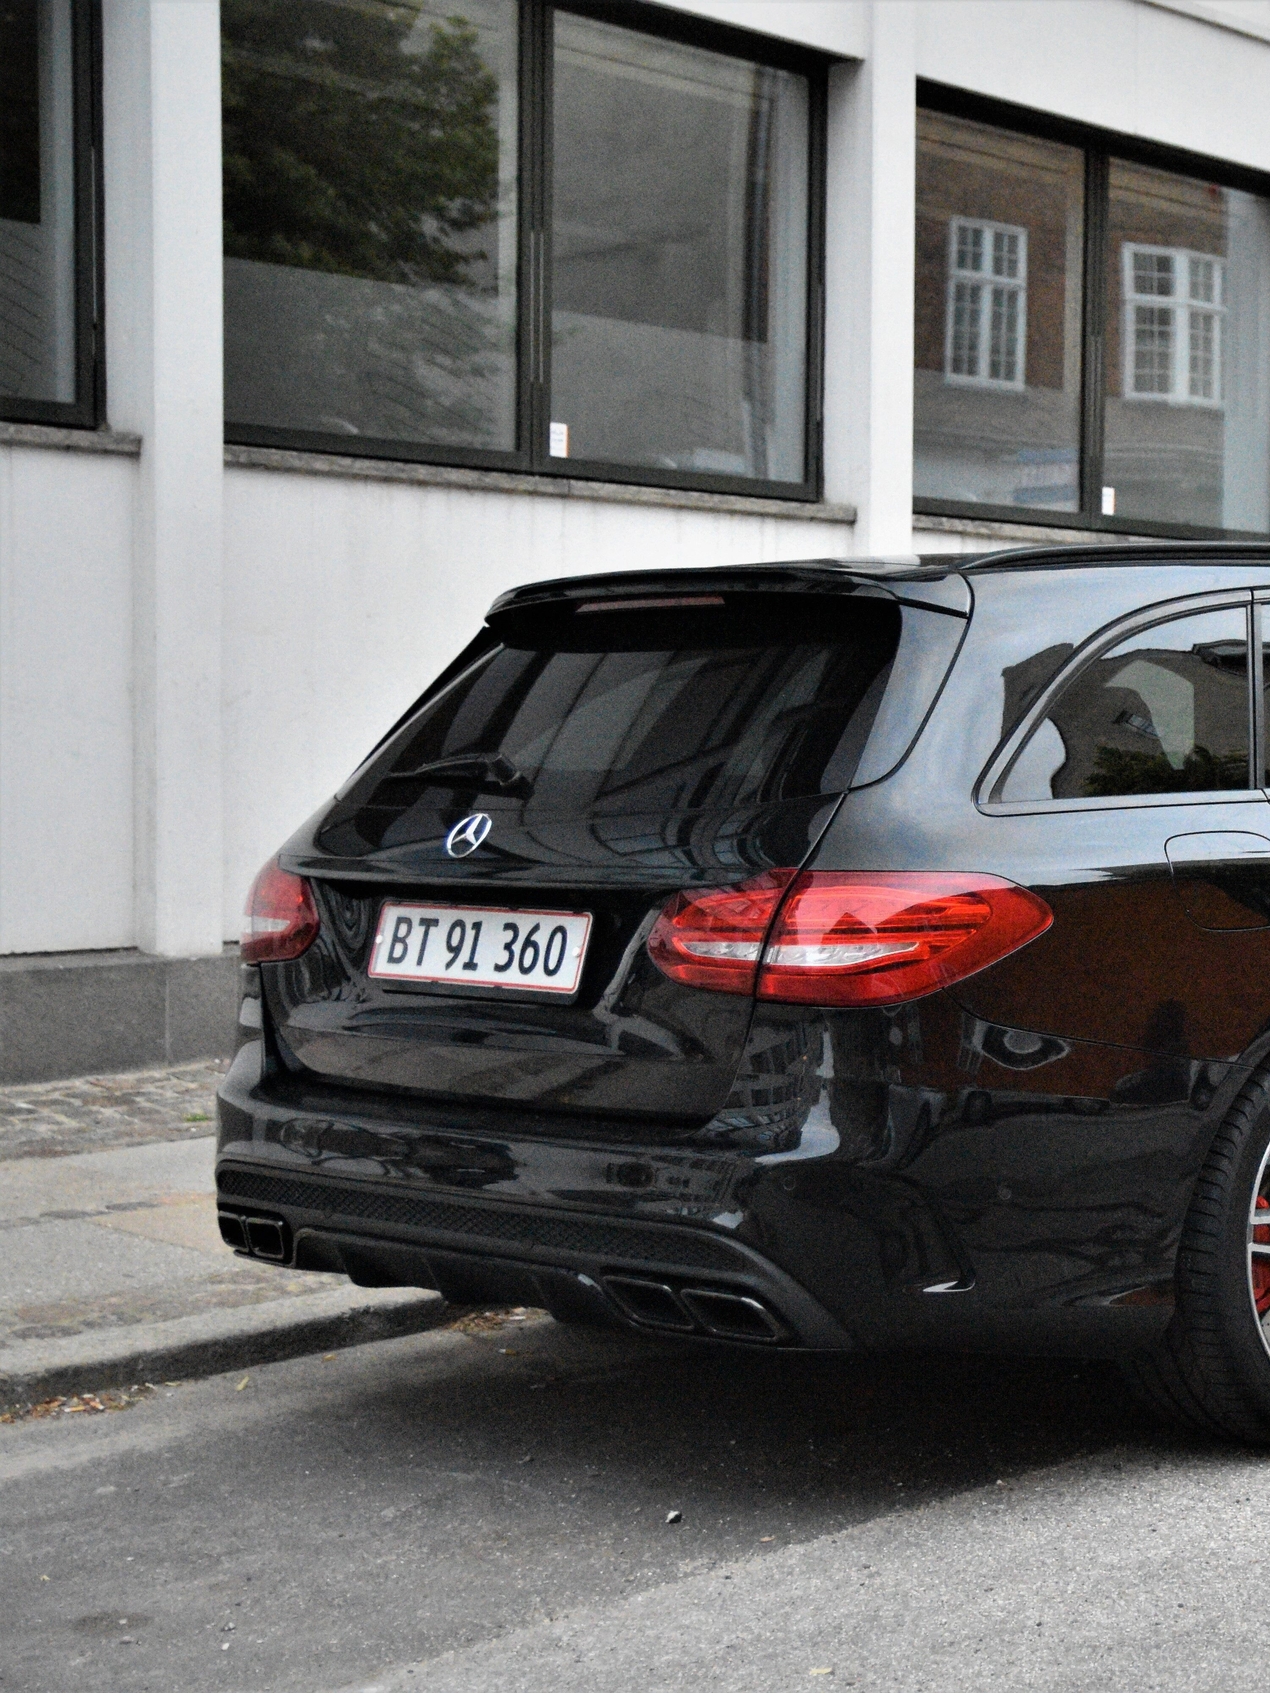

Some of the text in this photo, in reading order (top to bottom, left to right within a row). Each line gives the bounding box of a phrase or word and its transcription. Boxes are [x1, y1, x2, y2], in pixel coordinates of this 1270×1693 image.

[386, 916, 568, 977] BT 91 360
